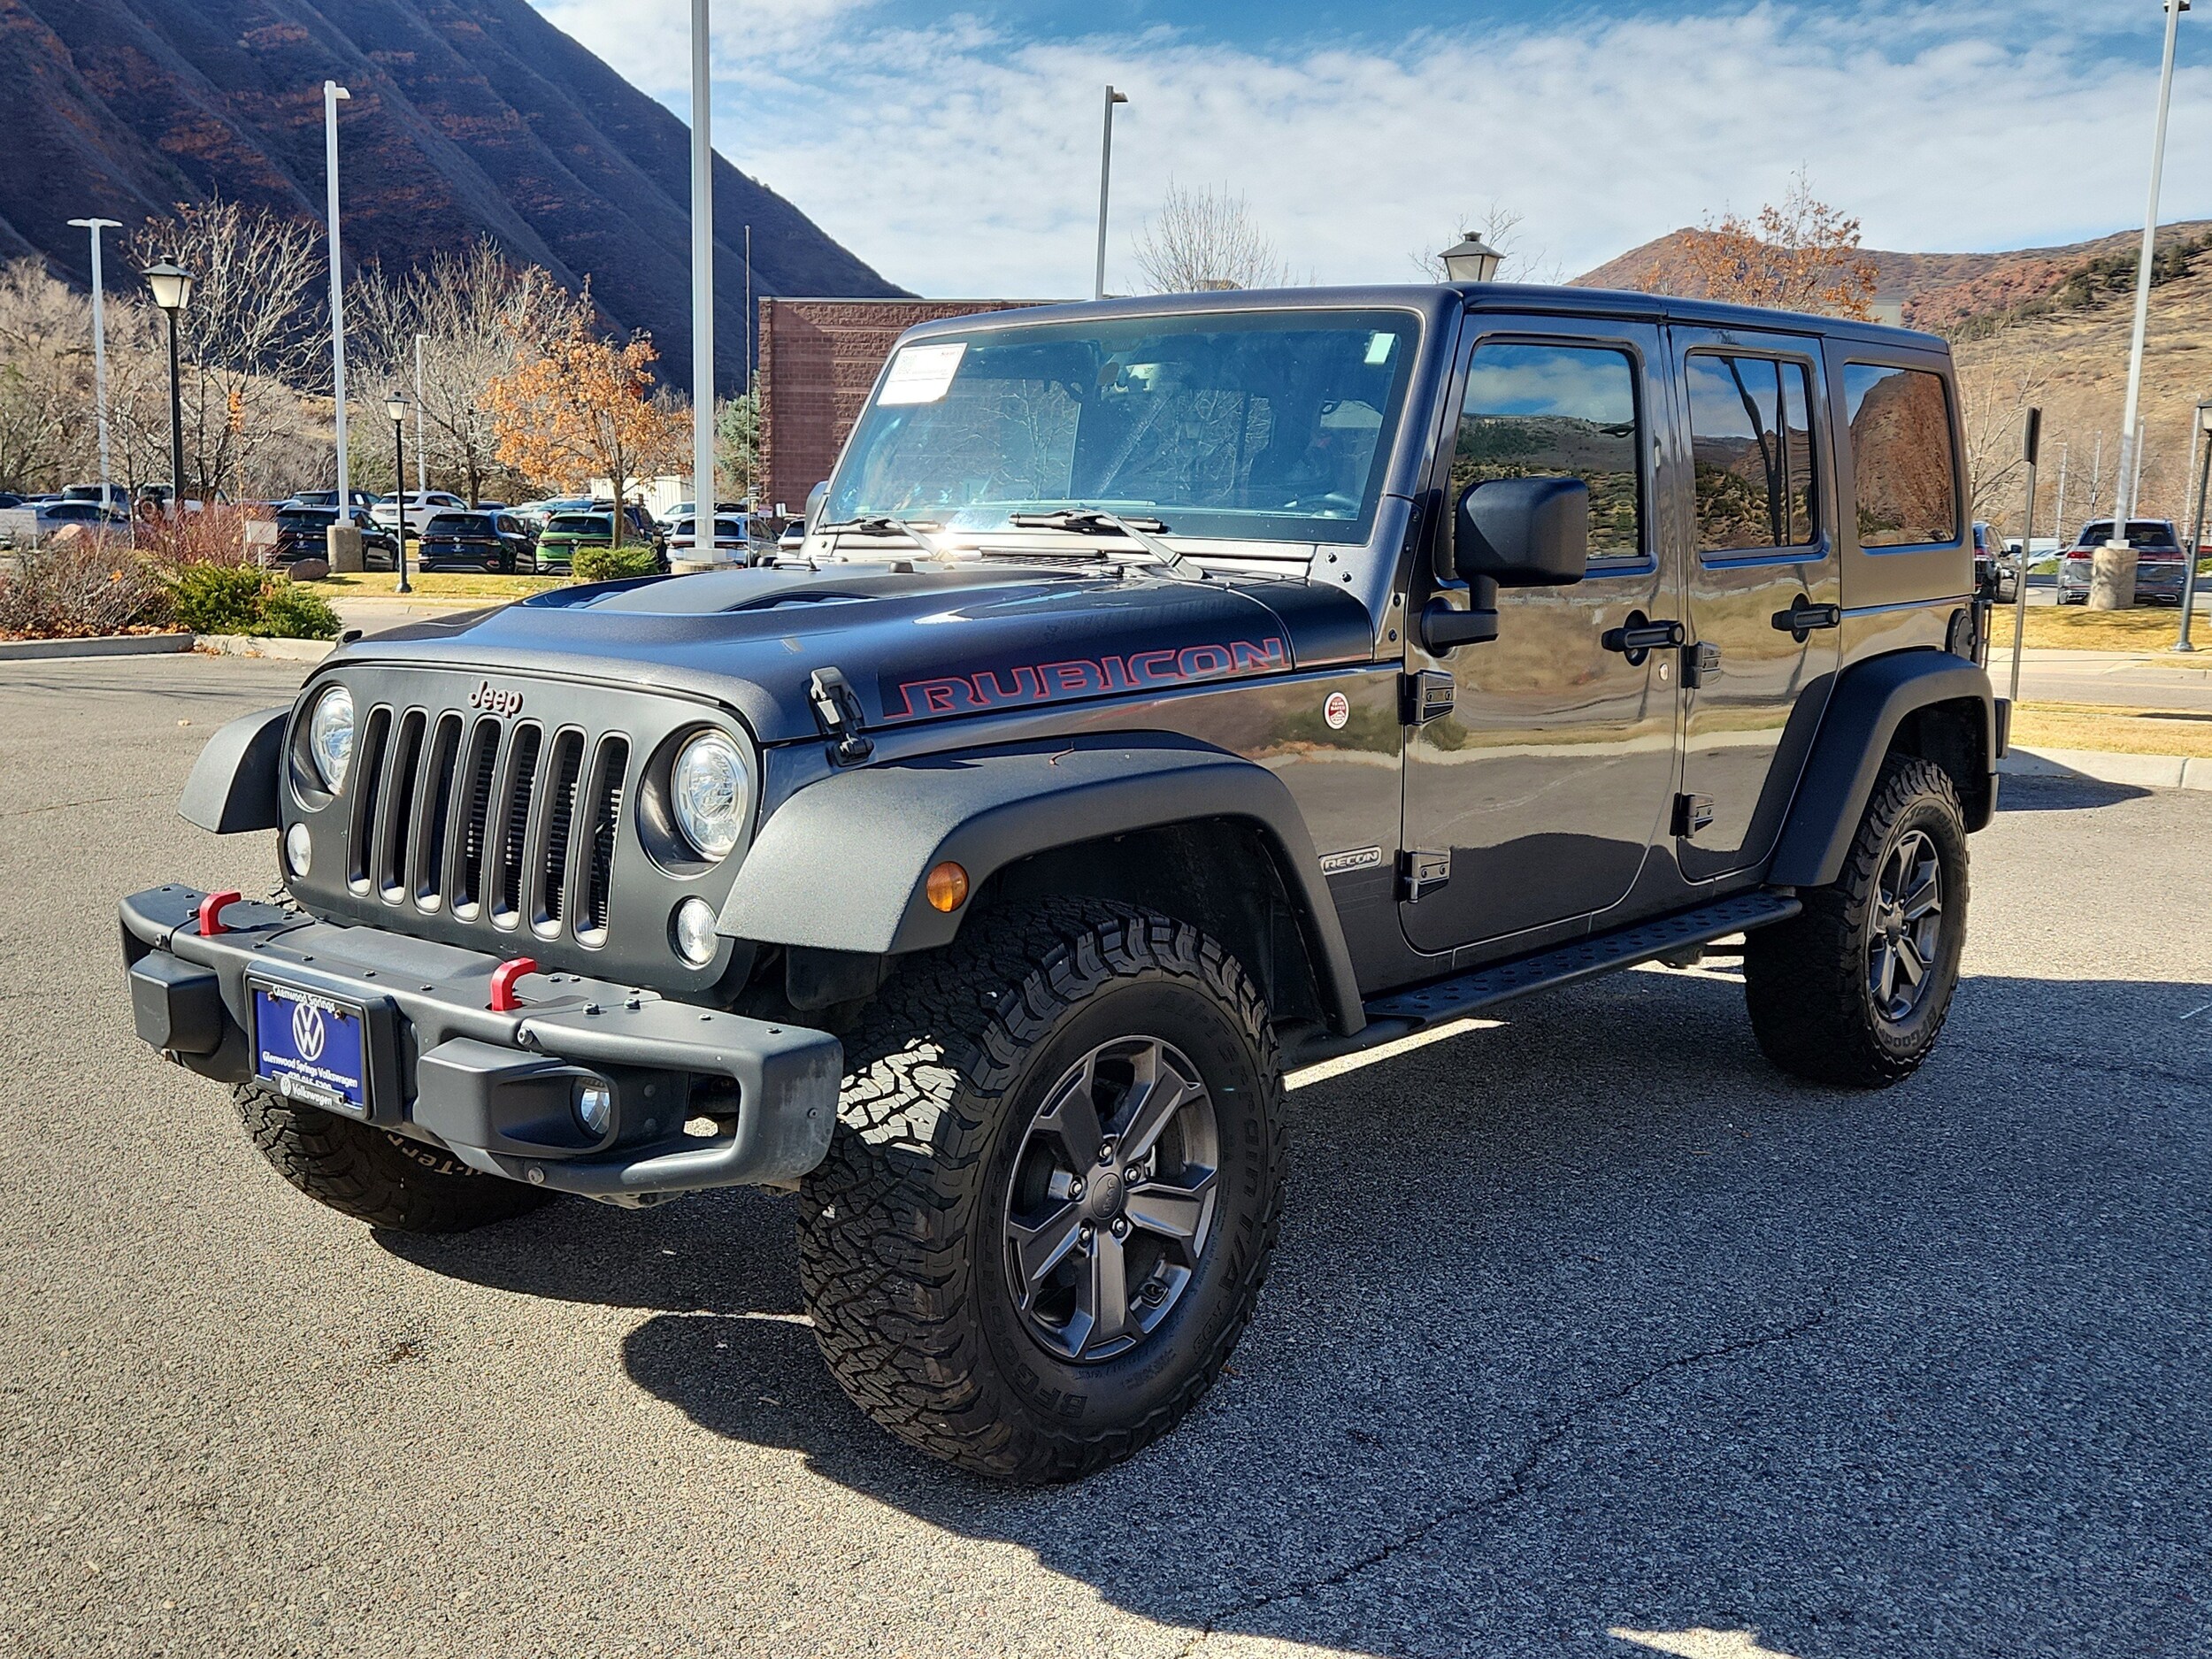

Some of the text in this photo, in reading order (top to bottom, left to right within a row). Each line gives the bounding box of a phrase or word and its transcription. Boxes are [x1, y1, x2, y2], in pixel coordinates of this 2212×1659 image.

[884, 637, 1290, 718] RUBICON
[468, 680, 524, 719] Jeep
[1325, 851, 1379, 870] RECON
[263, 1051, 296, 1069] Glenwood
[296, 1060, 318, 1078] Springs
[318, 1067, 357, 1088] Volkswagen
[292, 1082, 333, 1107] Volkswagen
